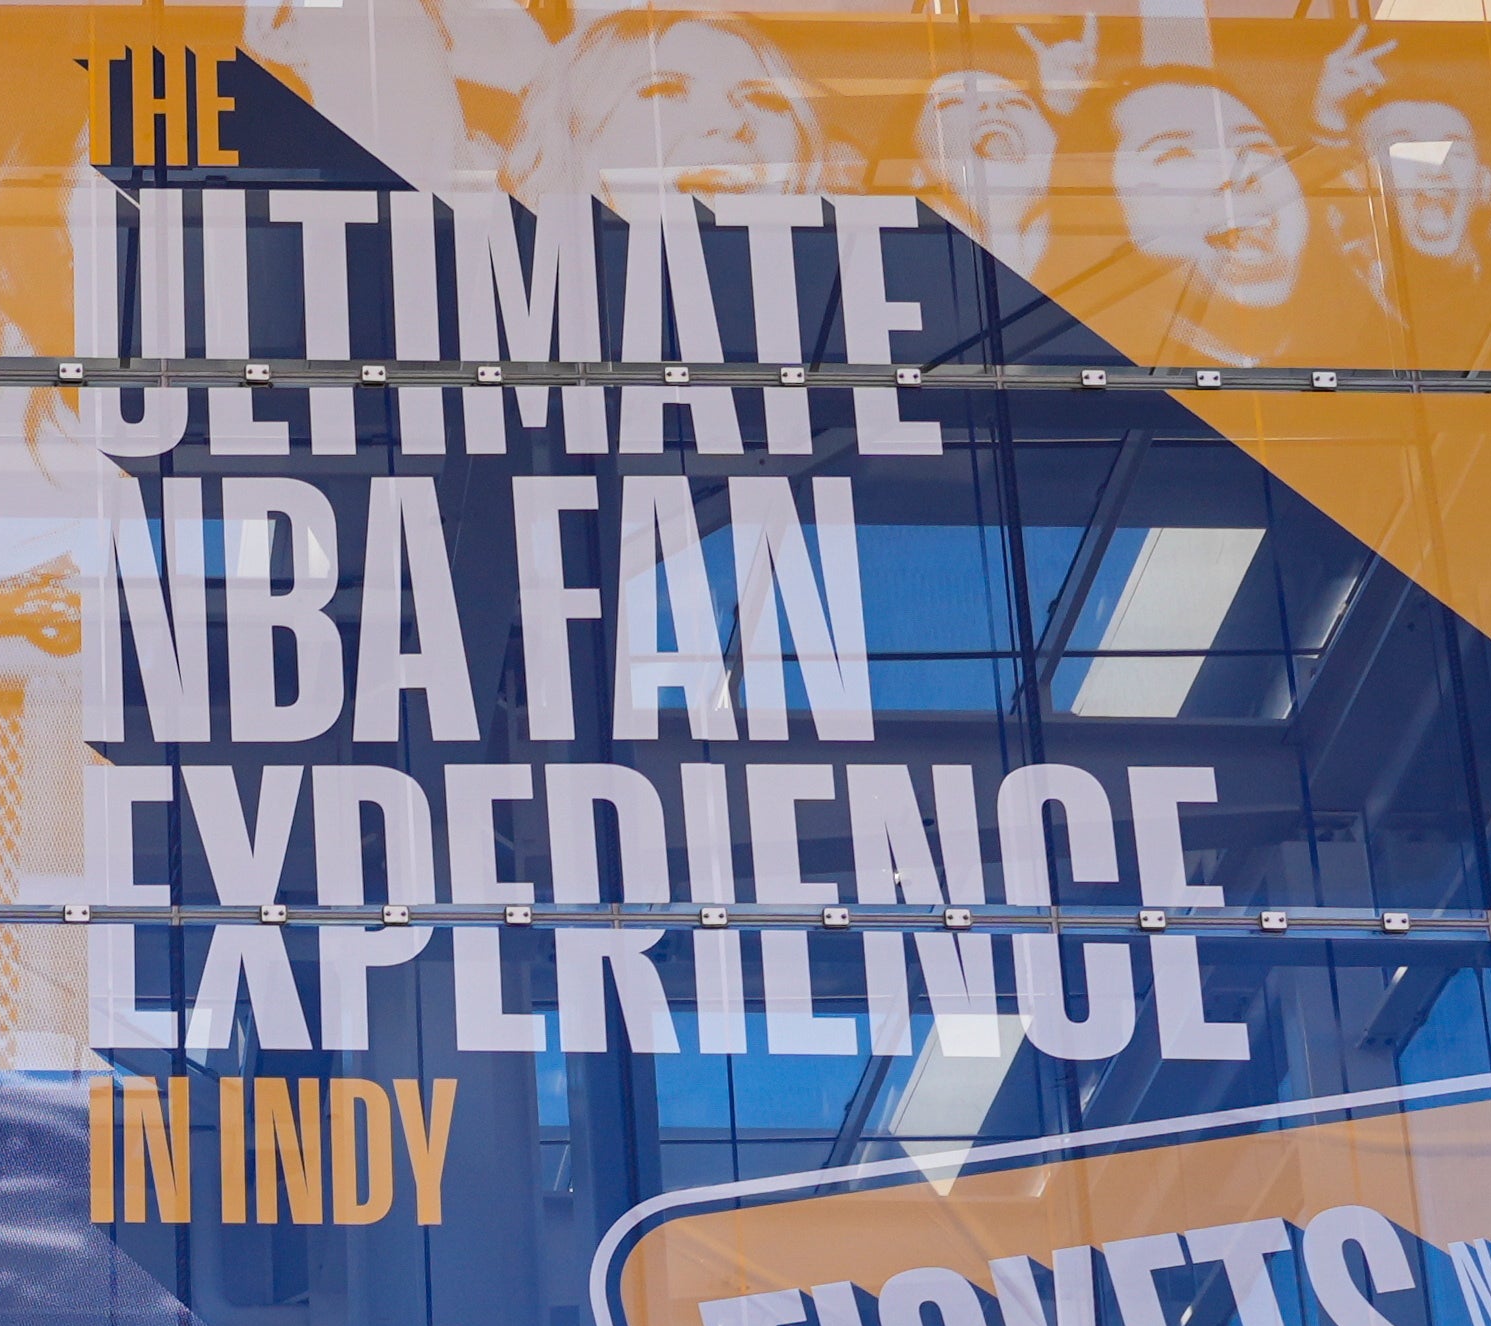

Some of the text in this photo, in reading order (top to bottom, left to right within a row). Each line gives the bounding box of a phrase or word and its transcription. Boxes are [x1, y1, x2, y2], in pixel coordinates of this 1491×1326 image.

[89, 45, 240, 167] THE
[102, 188, 943, 456] ULTIMATE
[104, 476, 876, 742] NBA FAN
[86, 764, 1251, 1060] EXPERIENCE
[89, 1077, 458, 1226] IN INDY
